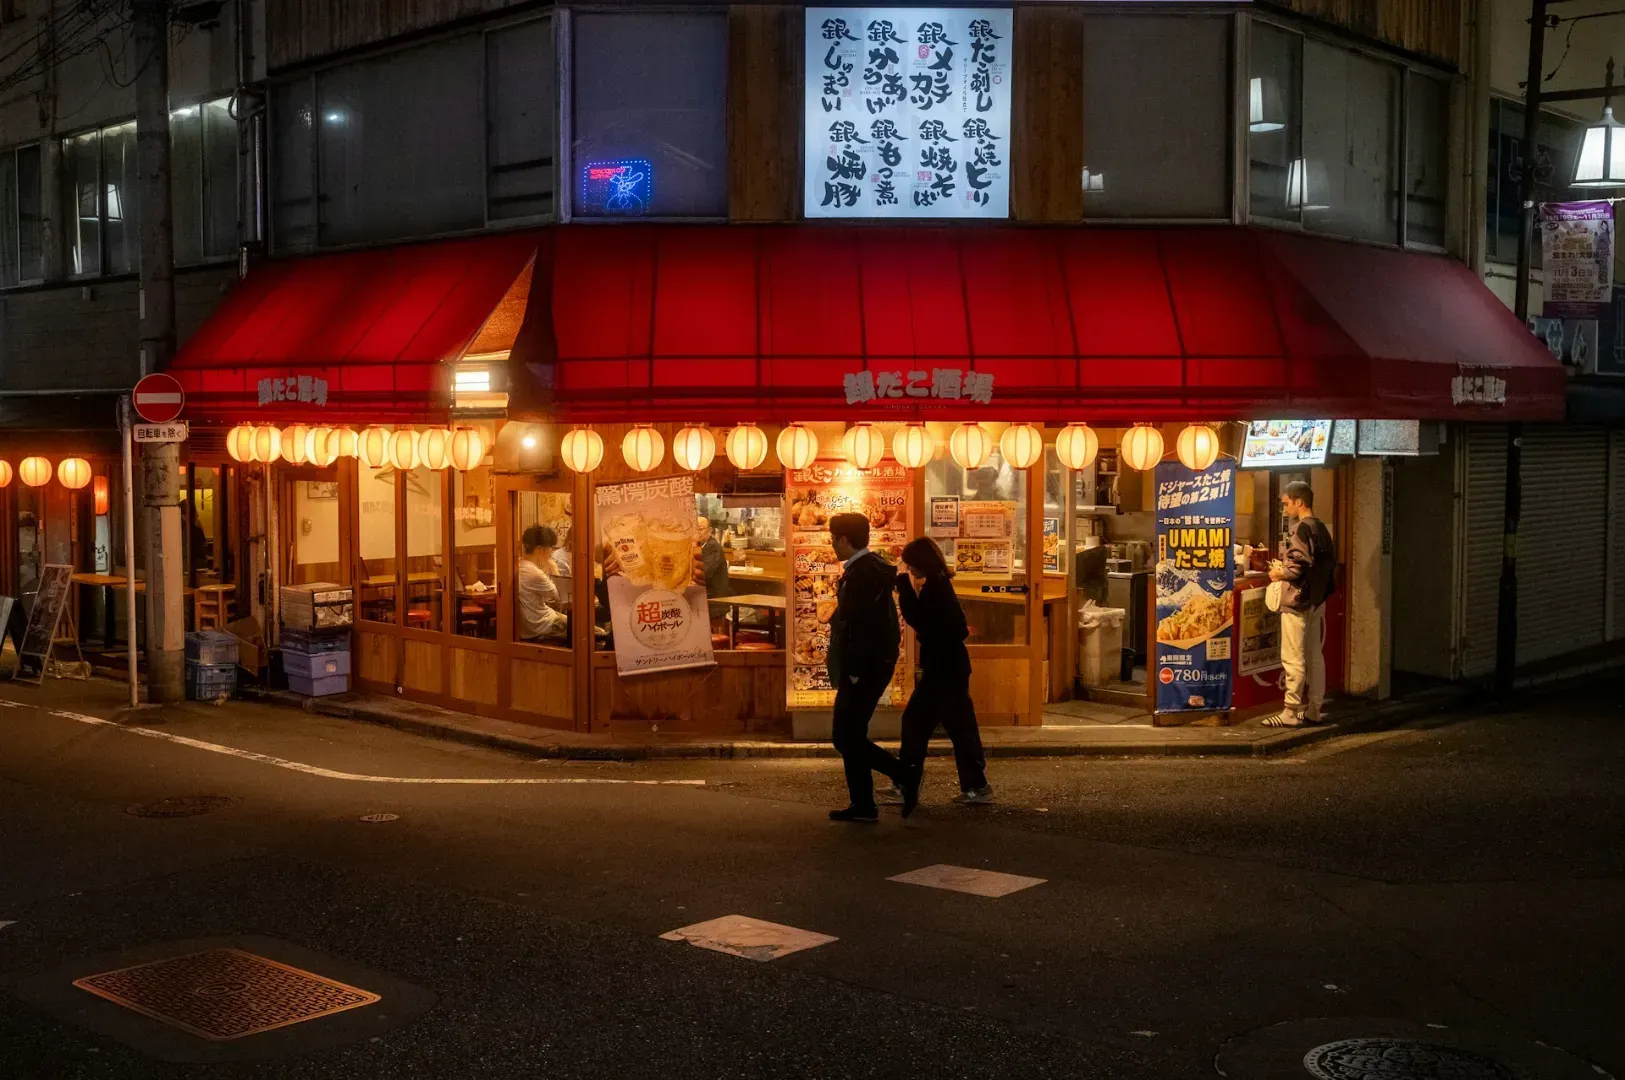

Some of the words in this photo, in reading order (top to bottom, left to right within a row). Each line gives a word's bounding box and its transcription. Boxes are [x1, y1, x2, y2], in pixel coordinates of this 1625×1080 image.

[138, 428, 181, 438] 自転車を除く
[1159, 469, 1231, 494] ドジャースたこ焼
[881, 497, 905, 505] BBQ
[1169, 528, 1230, 547] UMAMI
[1175, 548, 1225, 568] たこ焼
